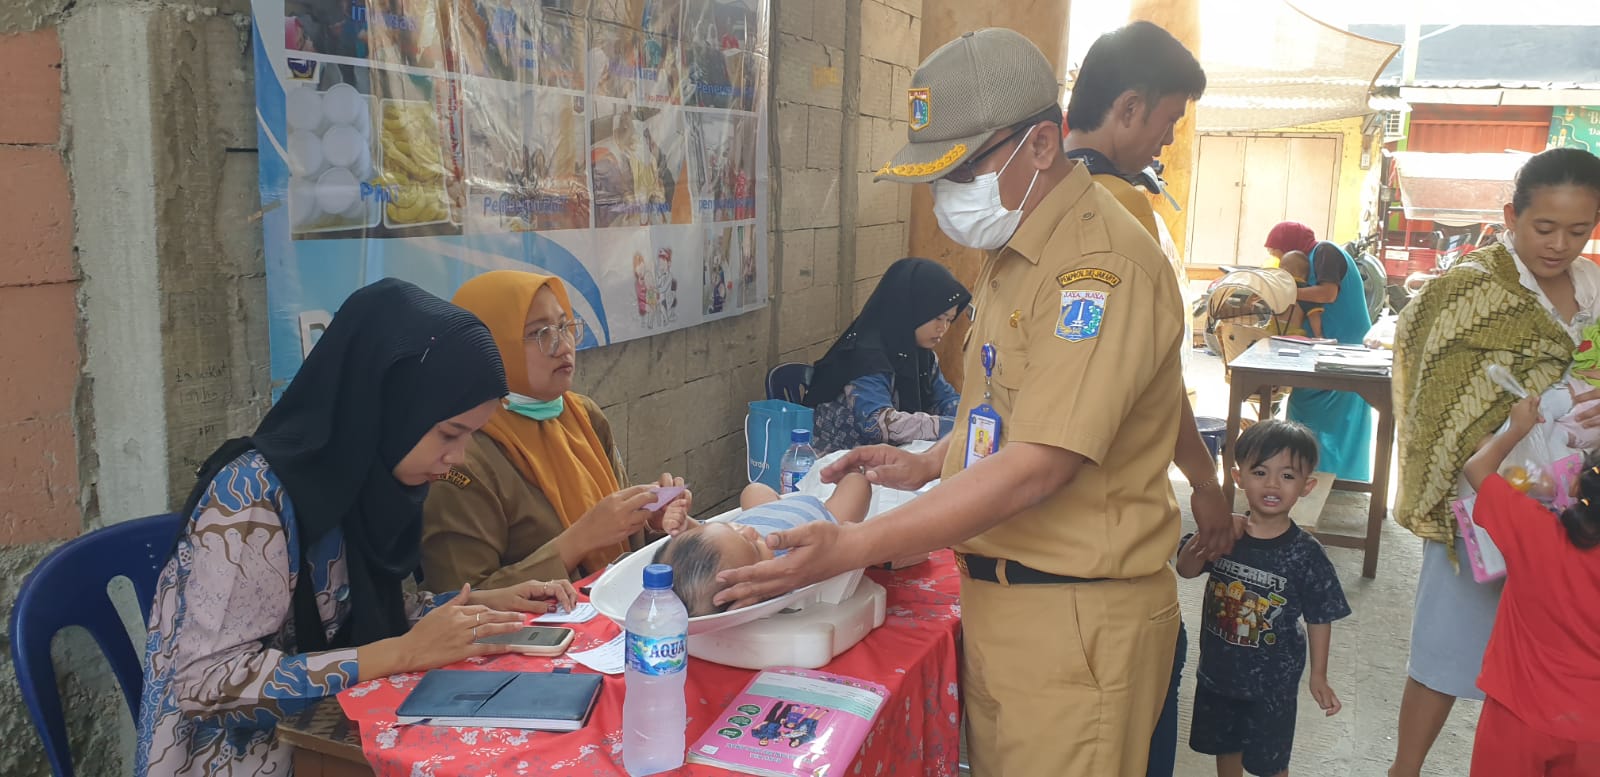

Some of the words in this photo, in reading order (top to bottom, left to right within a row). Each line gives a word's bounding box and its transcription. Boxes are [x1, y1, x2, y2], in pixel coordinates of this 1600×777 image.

[1085, 292, 1105, 300] RAYA
[1213, 557, 1287, 593] MINECRAFT
[649, 640, 685, 658] AQUA
